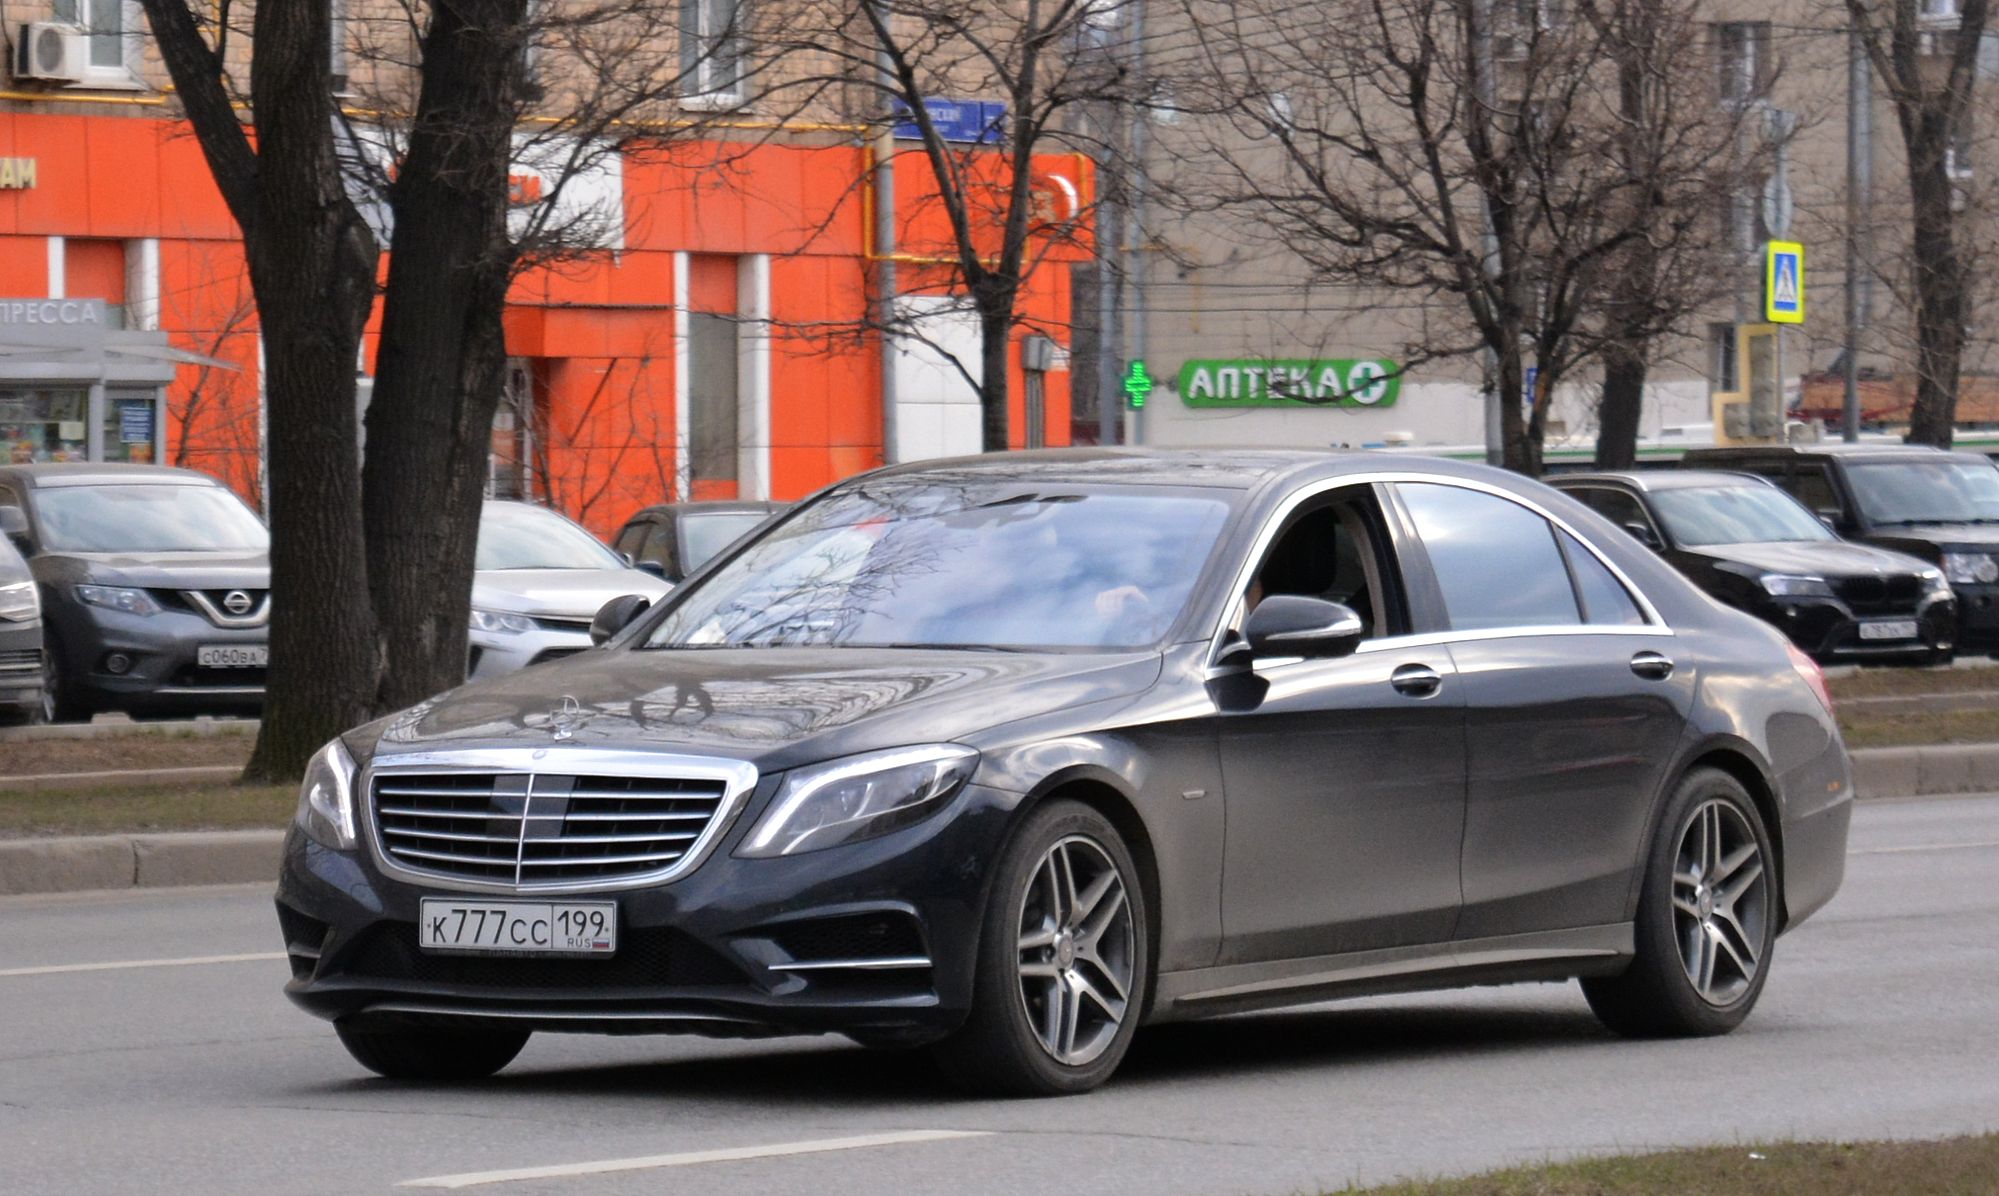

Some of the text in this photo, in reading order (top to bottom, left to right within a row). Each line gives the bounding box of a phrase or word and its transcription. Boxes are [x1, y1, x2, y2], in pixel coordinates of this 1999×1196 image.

[1188, 367, 1342, 399] АПТЕКА
[557, 910, 605, 938] 199
[567, 937, 592, 948] RUS
